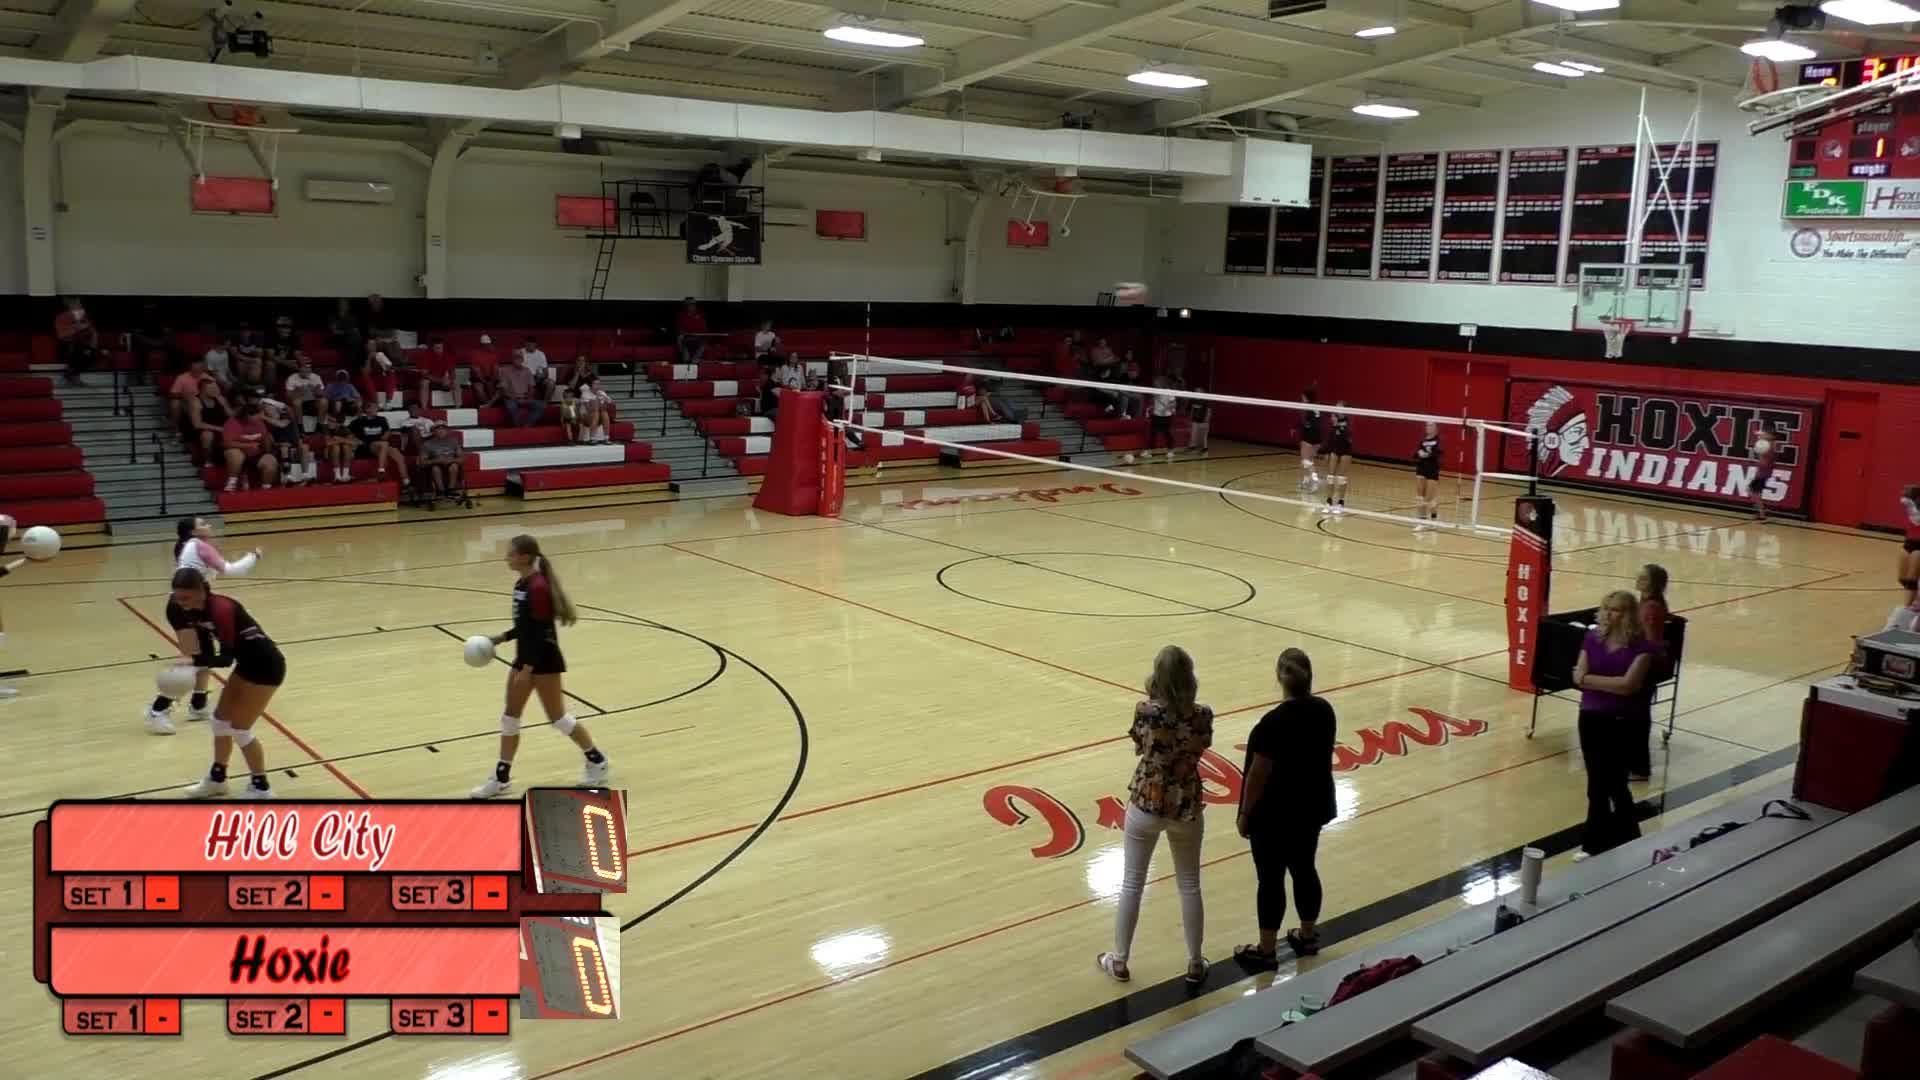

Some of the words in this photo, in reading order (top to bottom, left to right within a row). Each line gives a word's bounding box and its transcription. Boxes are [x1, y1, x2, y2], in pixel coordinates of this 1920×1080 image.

[1593, 392, 1802, 466] HOXIE
[1585, 447, 1792, 501] INDIANS
[1516, 563, 1531, 666] HOXIE
